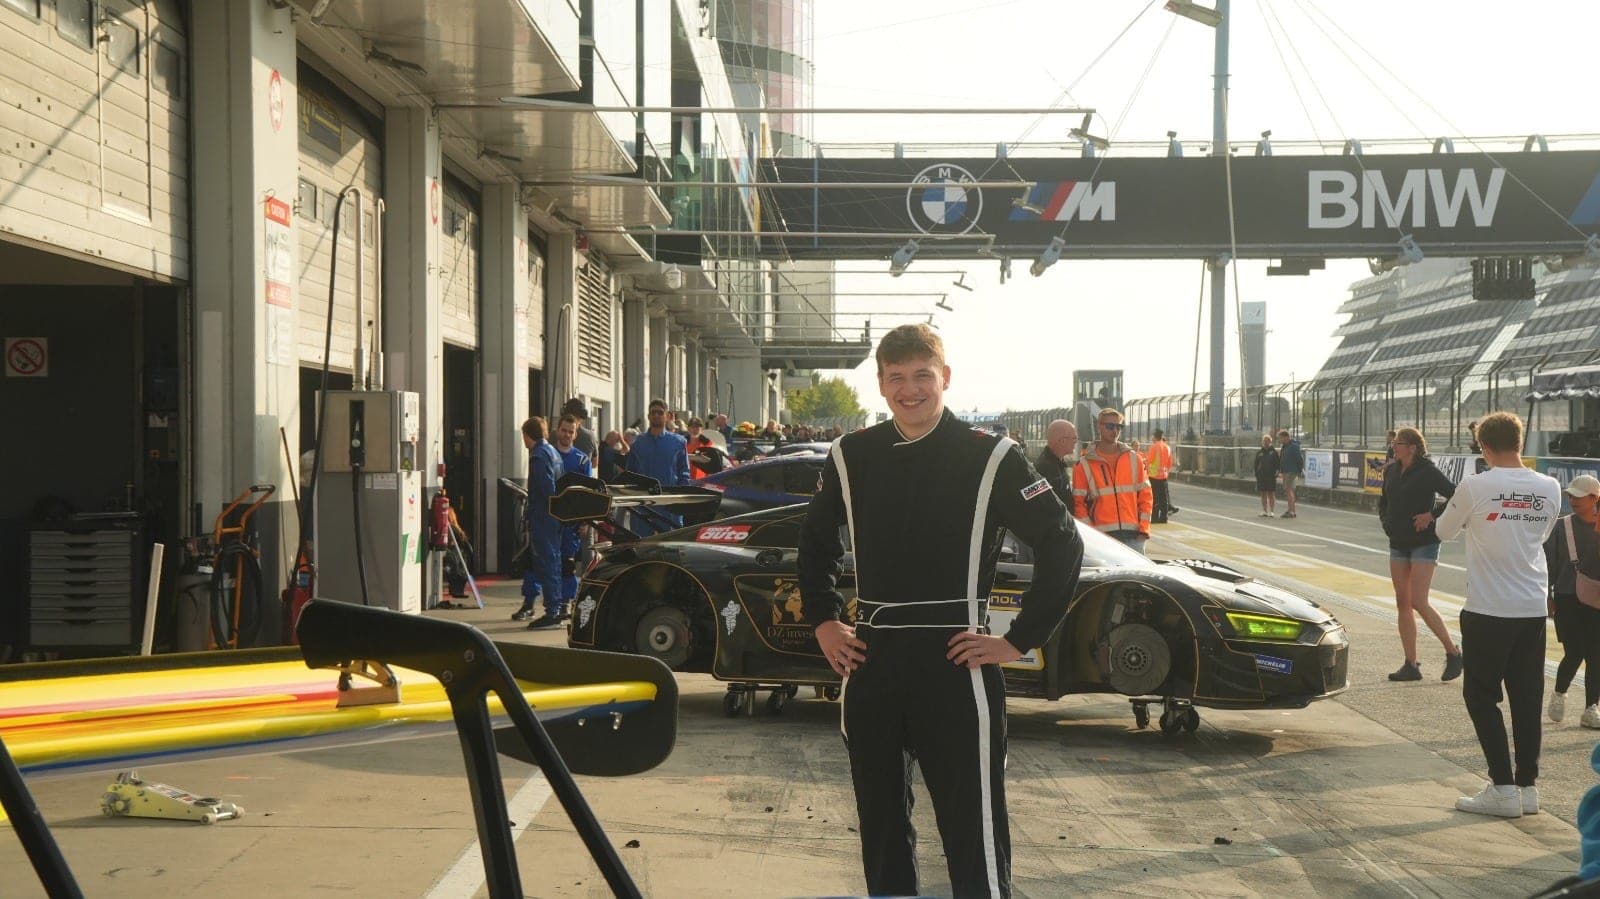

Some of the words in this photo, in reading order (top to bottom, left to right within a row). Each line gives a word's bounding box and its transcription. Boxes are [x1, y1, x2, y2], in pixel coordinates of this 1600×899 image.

[1308, 167, 1507, 230] BMW
[1500, 512, 1521, 521] Audi
[1523, 514, 1548, 523] Sport
[700, 530, 749, 540] auto
